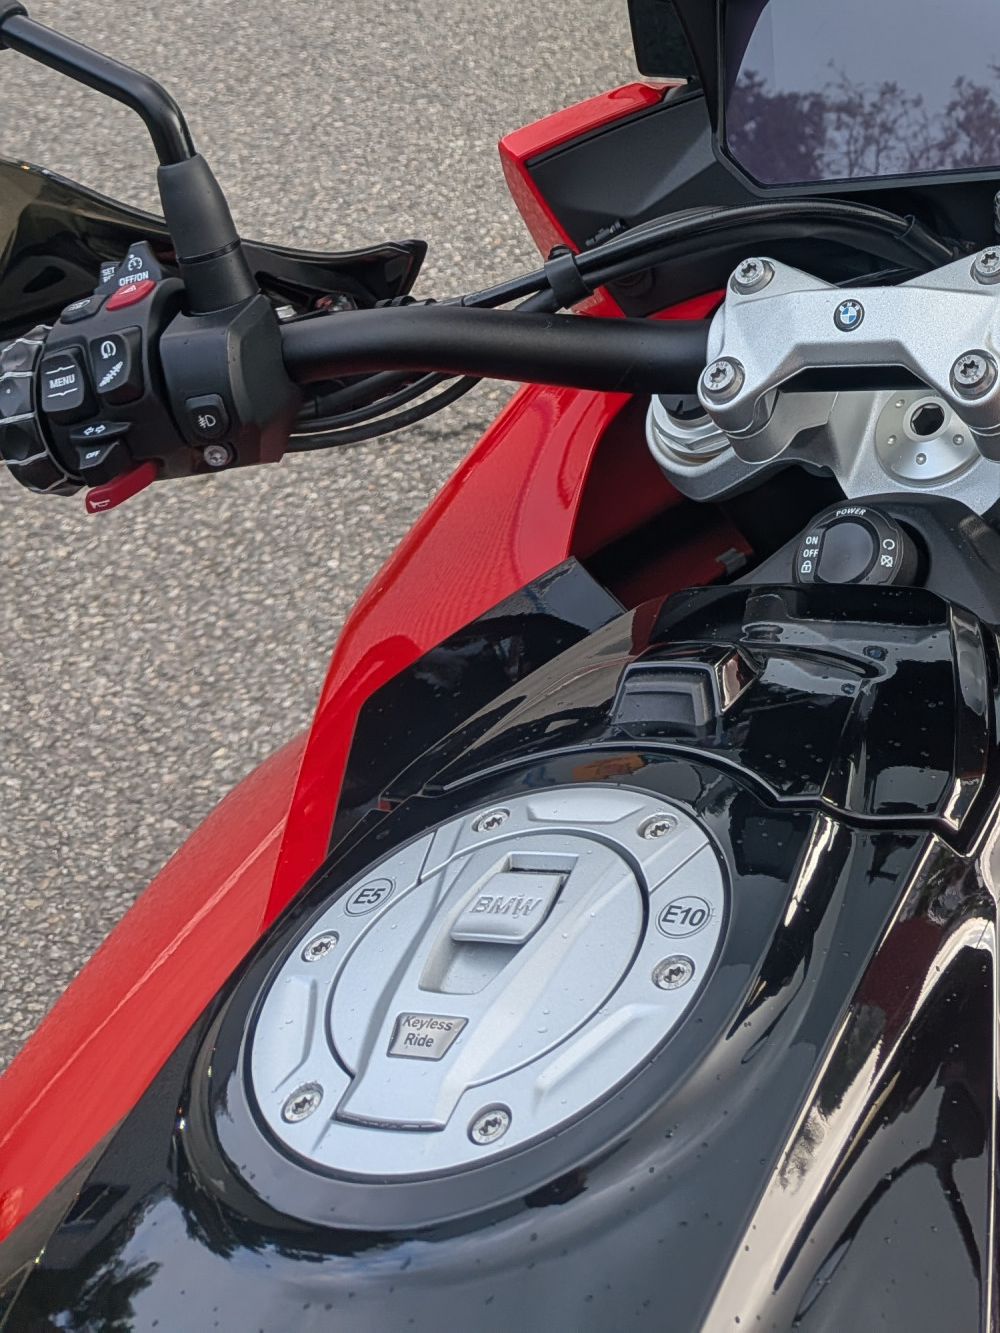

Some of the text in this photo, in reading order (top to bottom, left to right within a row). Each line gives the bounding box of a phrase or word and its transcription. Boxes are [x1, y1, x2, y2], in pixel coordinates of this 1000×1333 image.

[119, 271, 149, 286] OFF/ON
[49, 374, 75, 389] MENU
[86, 450, 100, 459] OFF
[835, 506, 867, 517] POWER
[805, 536, 819, 545] ON
[802, 548, 819, 558] OFF
[353, 888, 386, 906] E5
[469, 894, 542, 916] BMW
[659, 904, 706, 928] E10
[402, 1015, 454, 1032] Keyless
[403, 1032, 435, 1048] Ride
